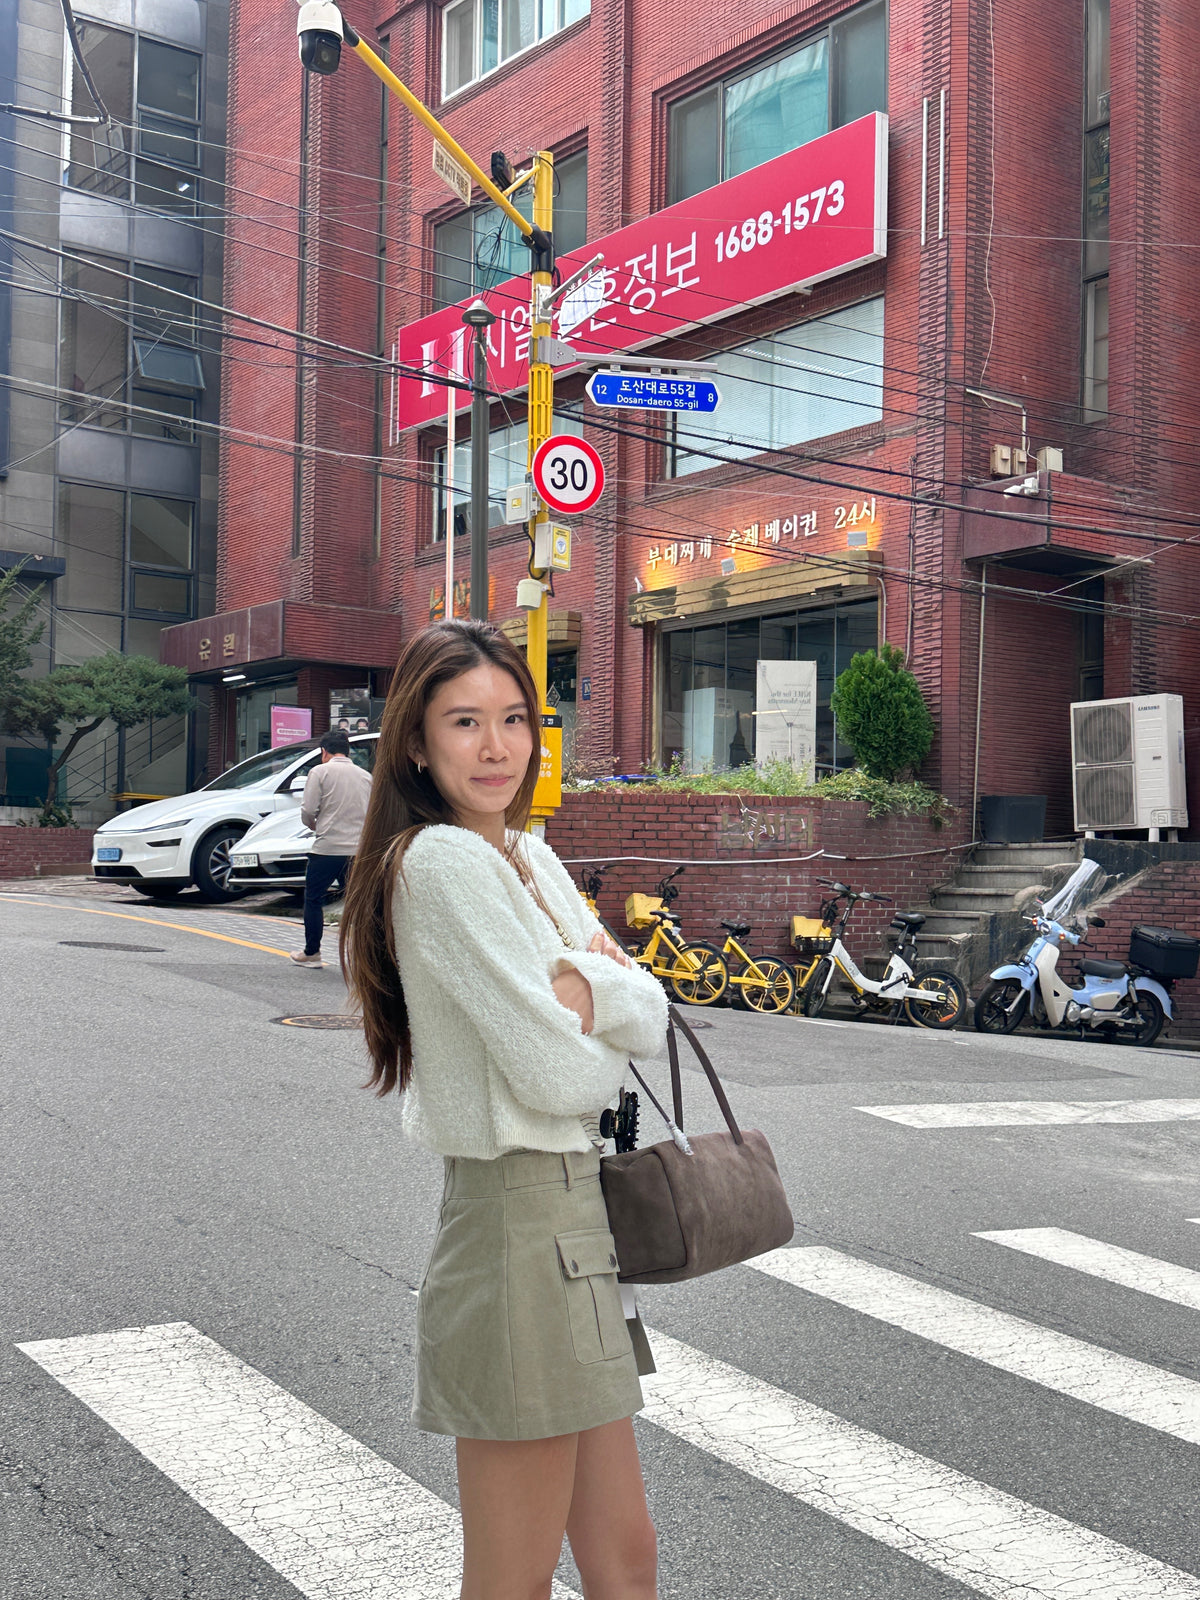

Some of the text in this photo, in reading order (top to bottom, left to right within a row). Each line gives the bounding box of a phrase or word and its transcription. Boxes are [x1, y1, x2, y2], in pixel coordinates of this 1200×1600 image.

[714, 180, 845, 263] 1688-1573
[596, 385, 607, 395] 12
[620, 380, 696, 398] 도산대로55길
[708, 393, 714, 402] 8
[617, 394, 698, 410] Dosan-daero 55-gil
[550, 457, 587, 491] 30
[834, 497, 877, 530] 24시
